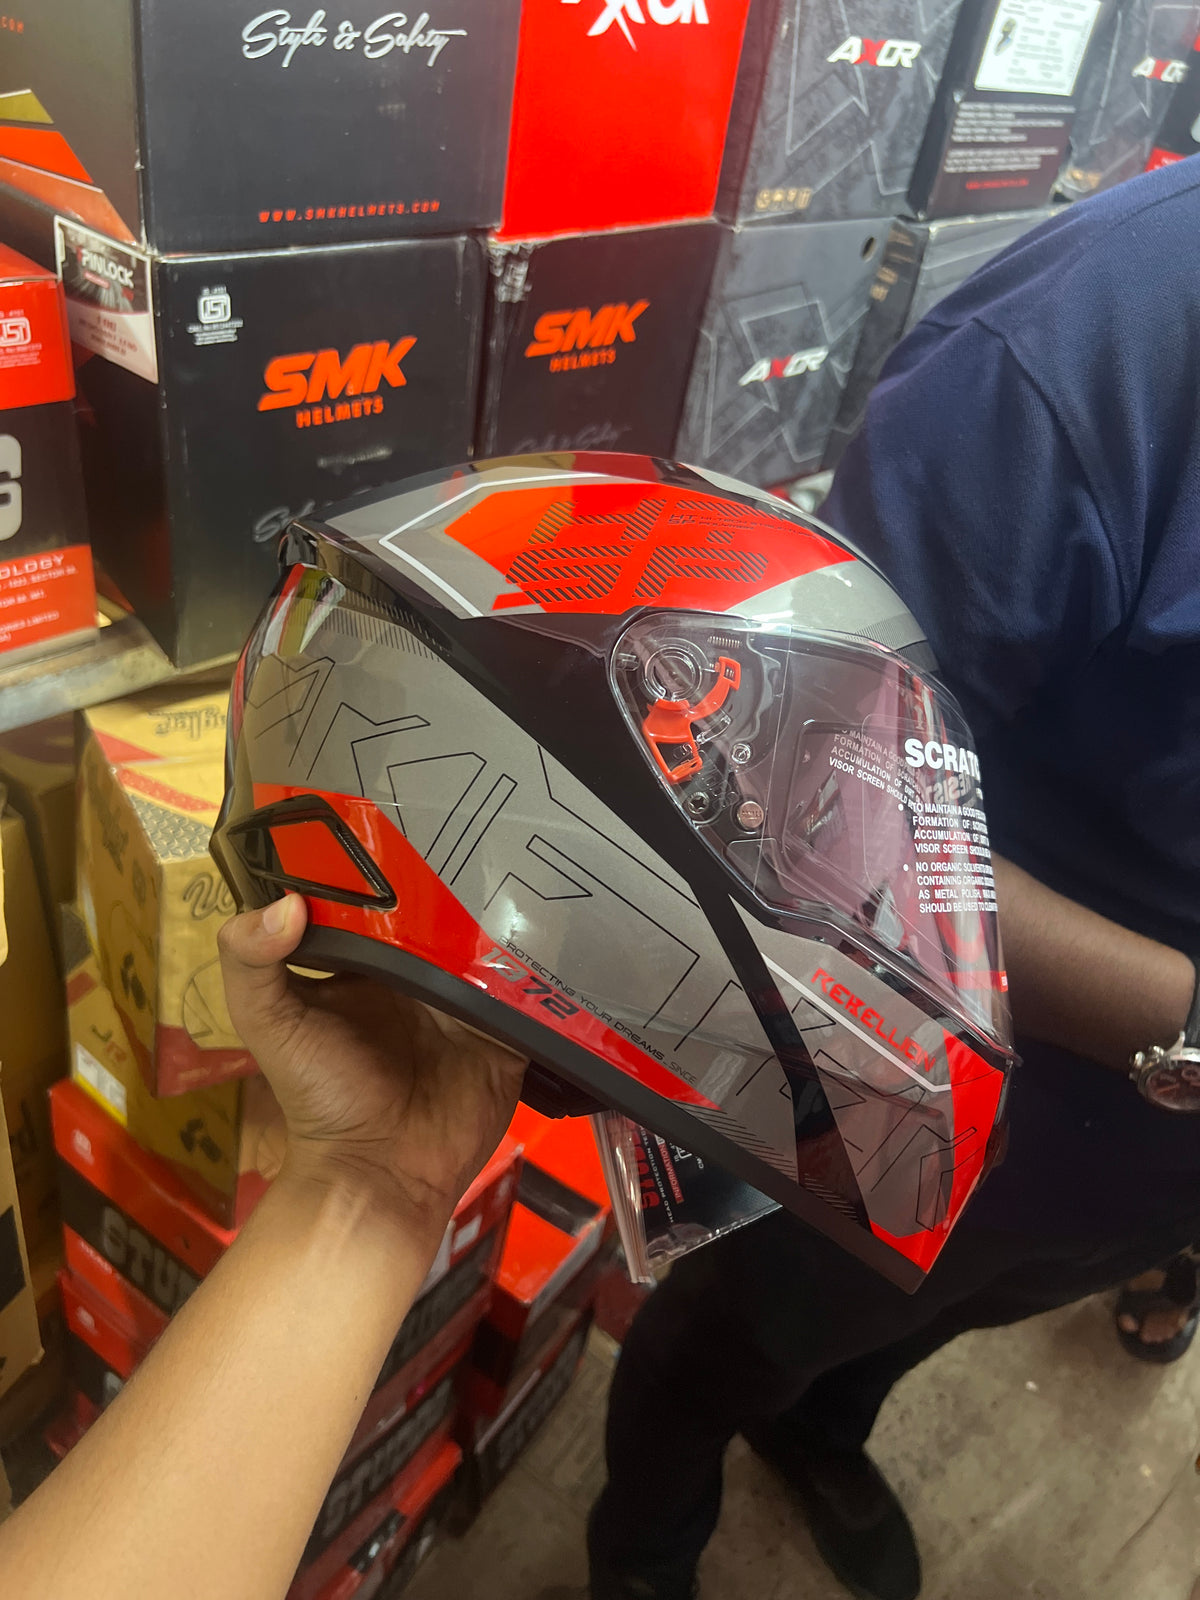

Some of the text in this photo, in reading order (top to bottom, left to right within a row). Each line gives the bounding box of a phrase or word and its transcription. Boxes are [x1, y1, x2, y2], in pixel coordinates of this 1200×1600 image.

[242, 9, 468, 68] Style & Safety
[826, 36, 922, 68] AXOR
[524, 299, 651, 359] SMK
[257, 334, 418, 412] SMK
[549, 349, 617, 373] HELMETS
[738, 345, 829, 386] AXOR
[295, 396, 384, 429] HELMETS
[831, 746, 891, 782] ACCUMULATION
[833, 734, 882, 764] FORMATION
[829, 756, 855, 776] VISOR
[856, 769, 885, 791] SCREEN
[913, 803, 924, 813] TO
[925, 804, 958, 816] MAINTAIN
[913, 816, 959, 828] FORMATION
[914, 830, 971, 842] ACCUMULATION
[915, 843, 941, 854] VISOR
[943, 844, 968, 855] SCREEN
[915, 862, 929, 872] NO
[930, 862, 963, 872] ORGANIC
[917, 876, 962, 886] CONTAINING
[918, 890, 931, 900] AS
[934, 889, 958, 899] METAL
[919, 903, 952, 914] SHOULD
[953, 903, 963, 913] BE
[500, 936, 577, 997] PROTECTING
[579, 995, 613, 1024] YOUR
[668, 1060, 698, 1086] SINCE
[648, 1147, 666, 1198] PROTECTION
[663, 1200, 675, 1223] HEAD
